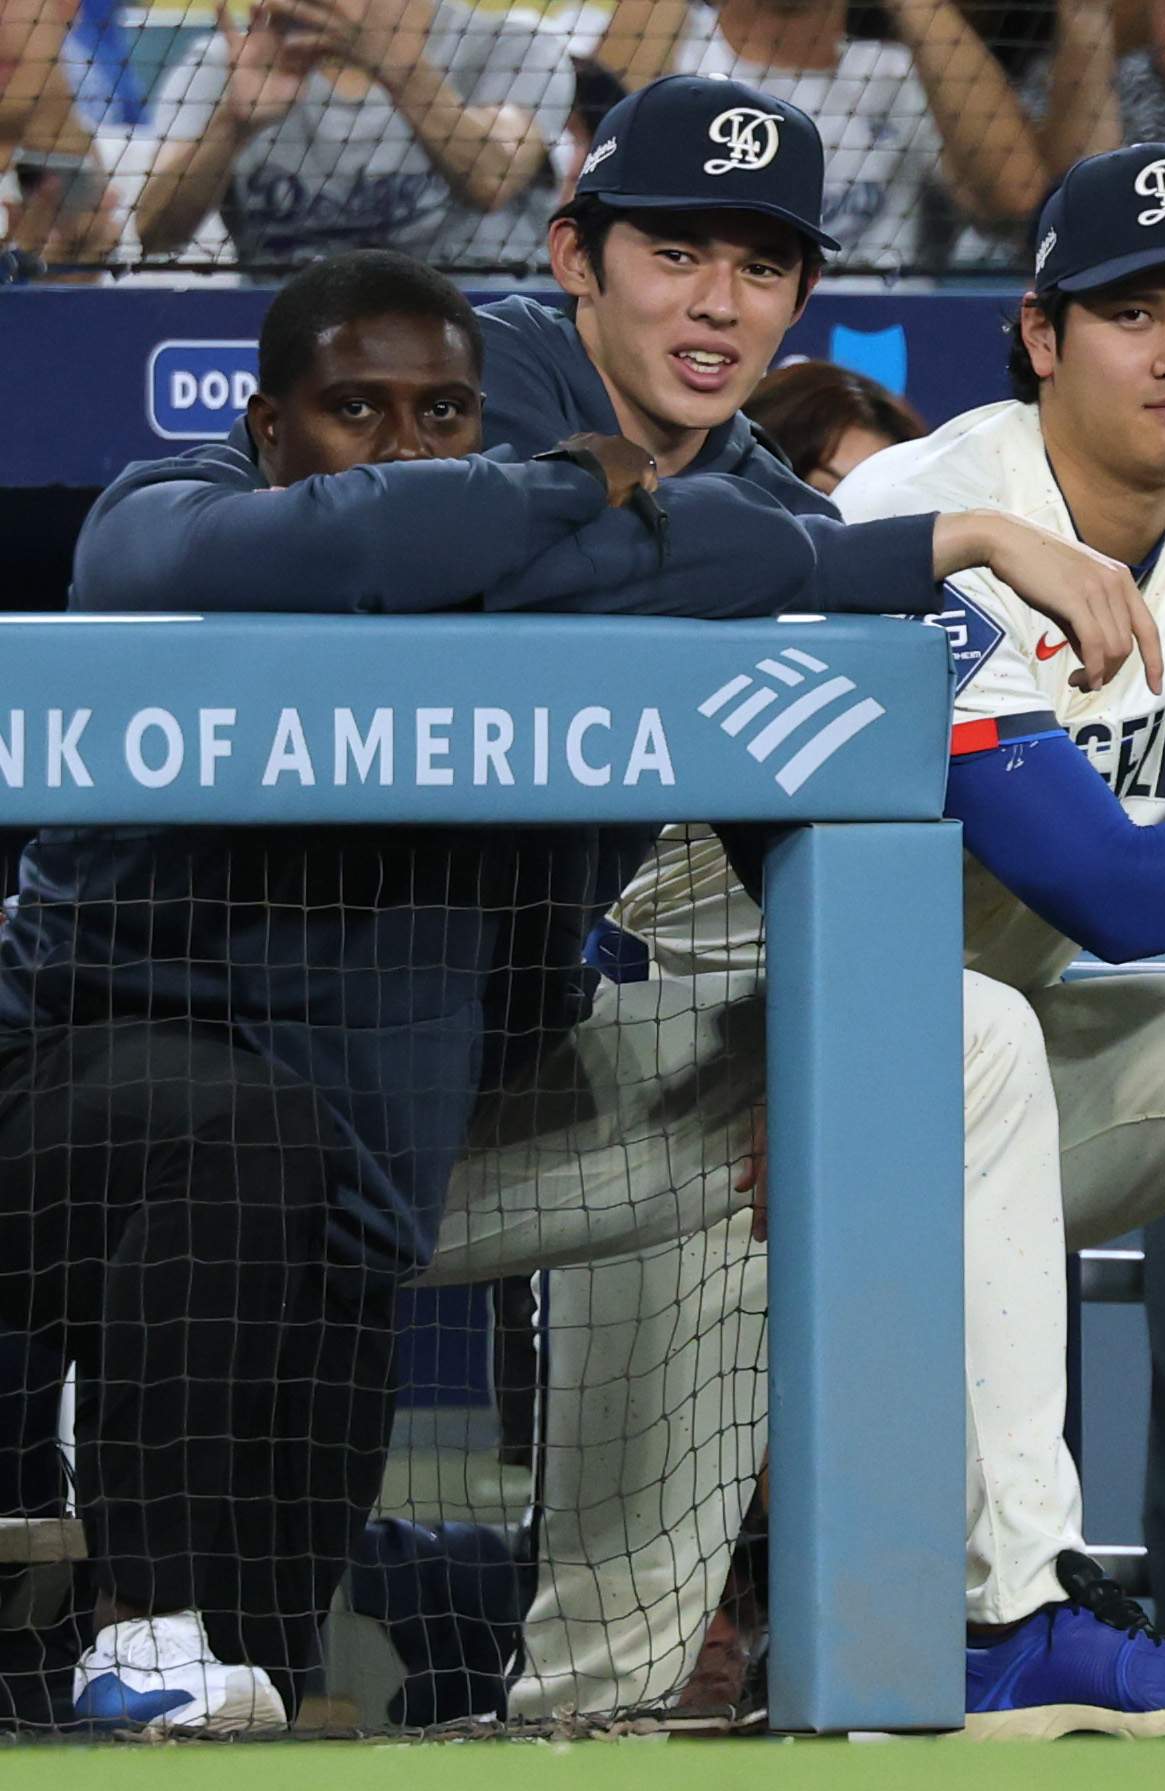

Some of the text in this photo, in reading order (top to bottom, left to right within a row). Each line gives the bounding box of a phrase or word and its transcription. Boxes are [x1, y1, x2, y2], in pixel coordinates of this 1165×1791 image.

[171, 370, 258, 410] DOD
[125, 706, 237, 789] OF
[261, 706, 676, 787] AMERICA
